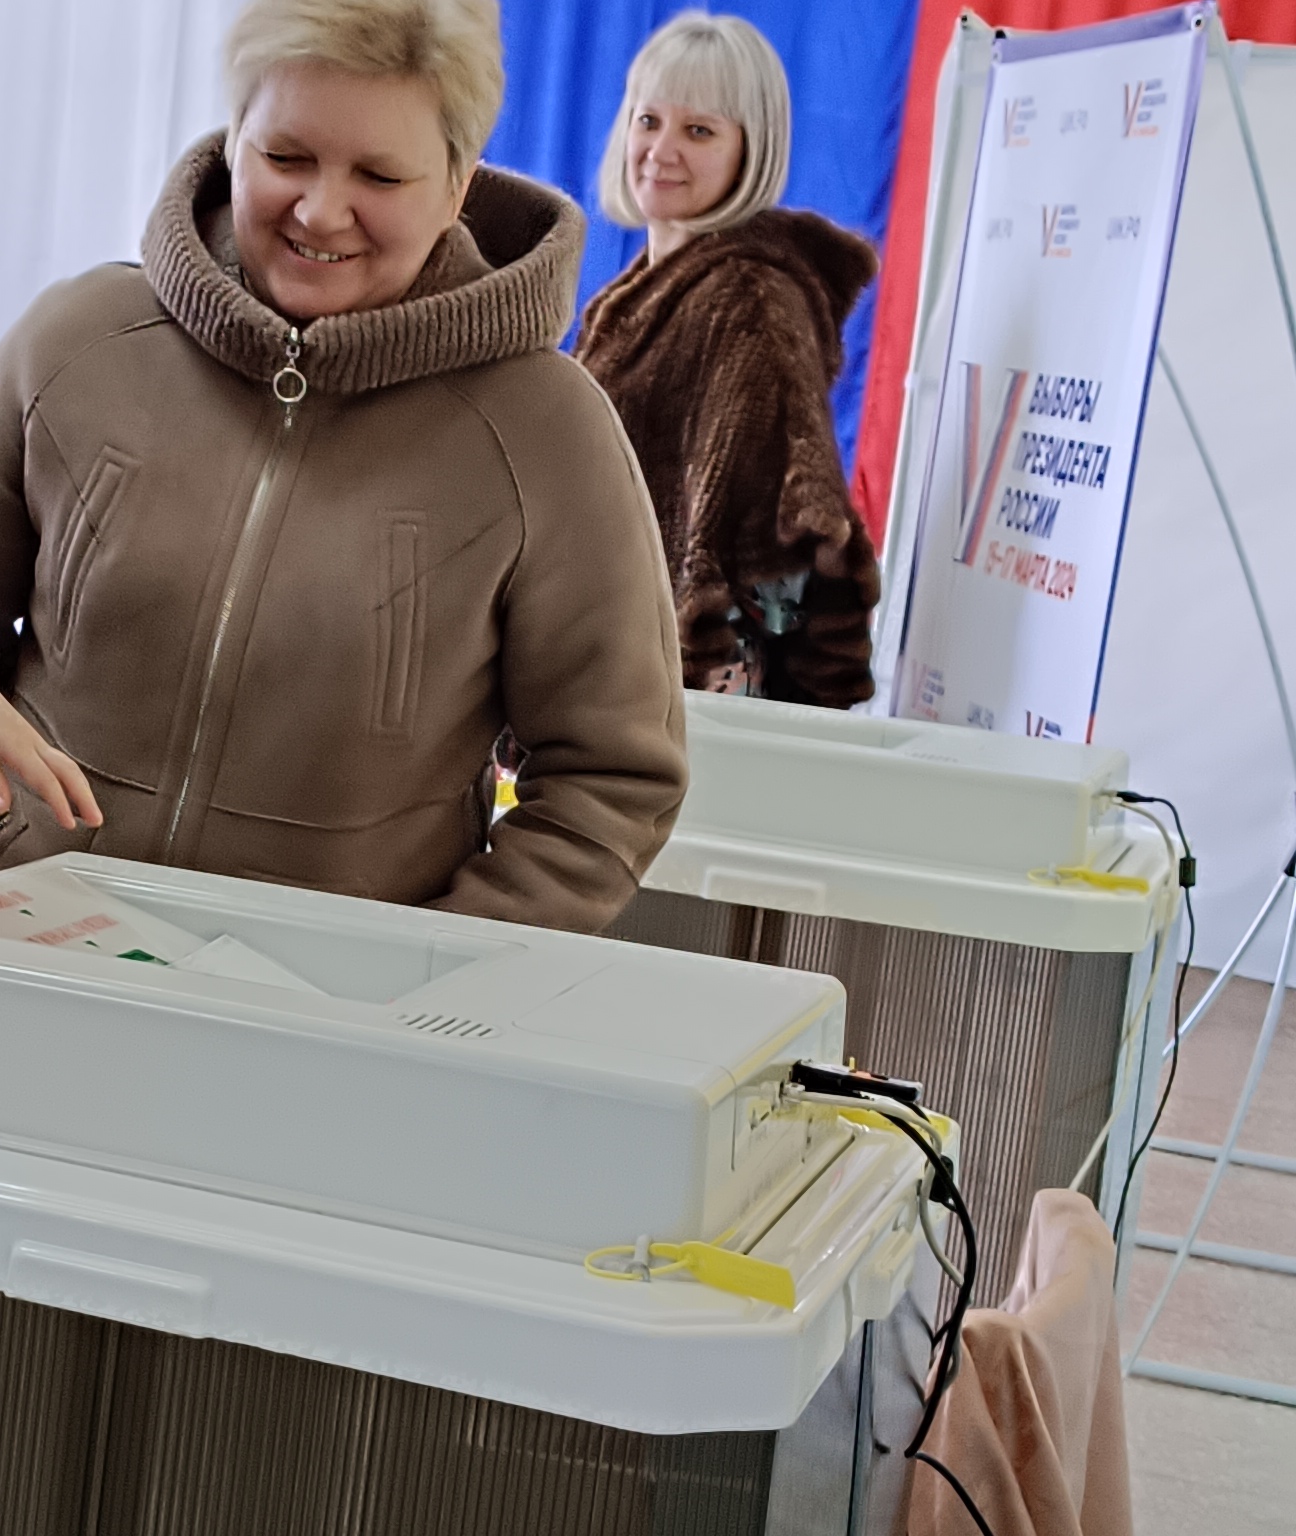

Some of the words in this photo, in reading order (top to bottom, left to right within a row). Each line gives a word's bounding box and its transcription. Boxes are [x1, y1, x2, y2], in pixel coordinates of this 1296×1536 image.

[1028, 372, 1103, 423] ВЫБОРЫ
[1012, 429, 1112, 489] ПРЕЗИДЕНТА
[996, 485, 1061, 539] РОССИИ
[1046, 559, 1078, 601] 2024
